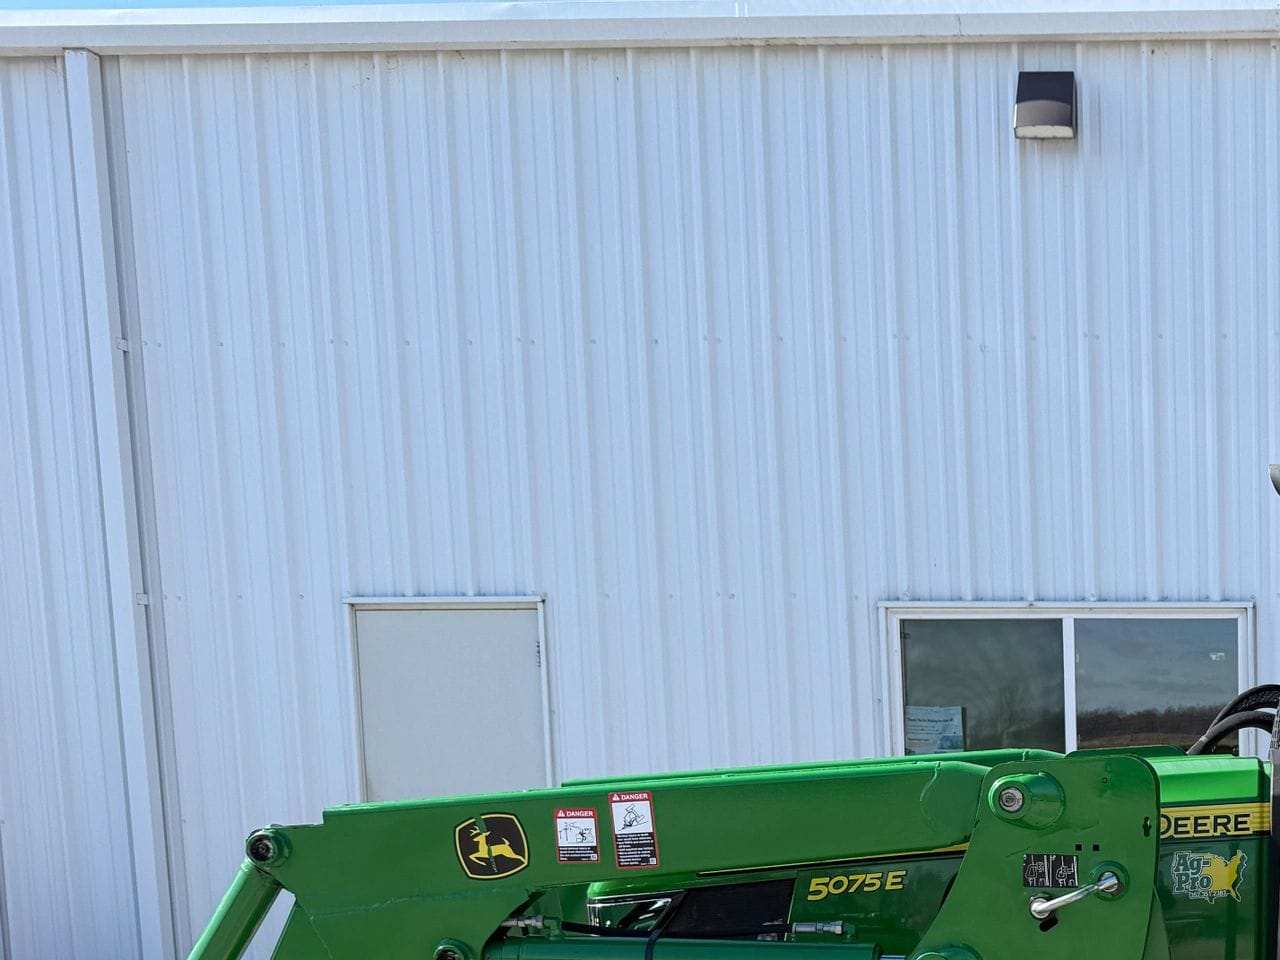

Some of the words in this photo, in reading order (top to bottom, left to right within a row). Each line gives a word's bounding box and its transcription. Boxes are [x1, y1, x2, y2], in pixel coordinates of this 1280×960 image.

[621, 793, 649, 801] DANGER
[566, 810, 594, 818] DANGER
[1174, 872, 1213, 893] Pro
